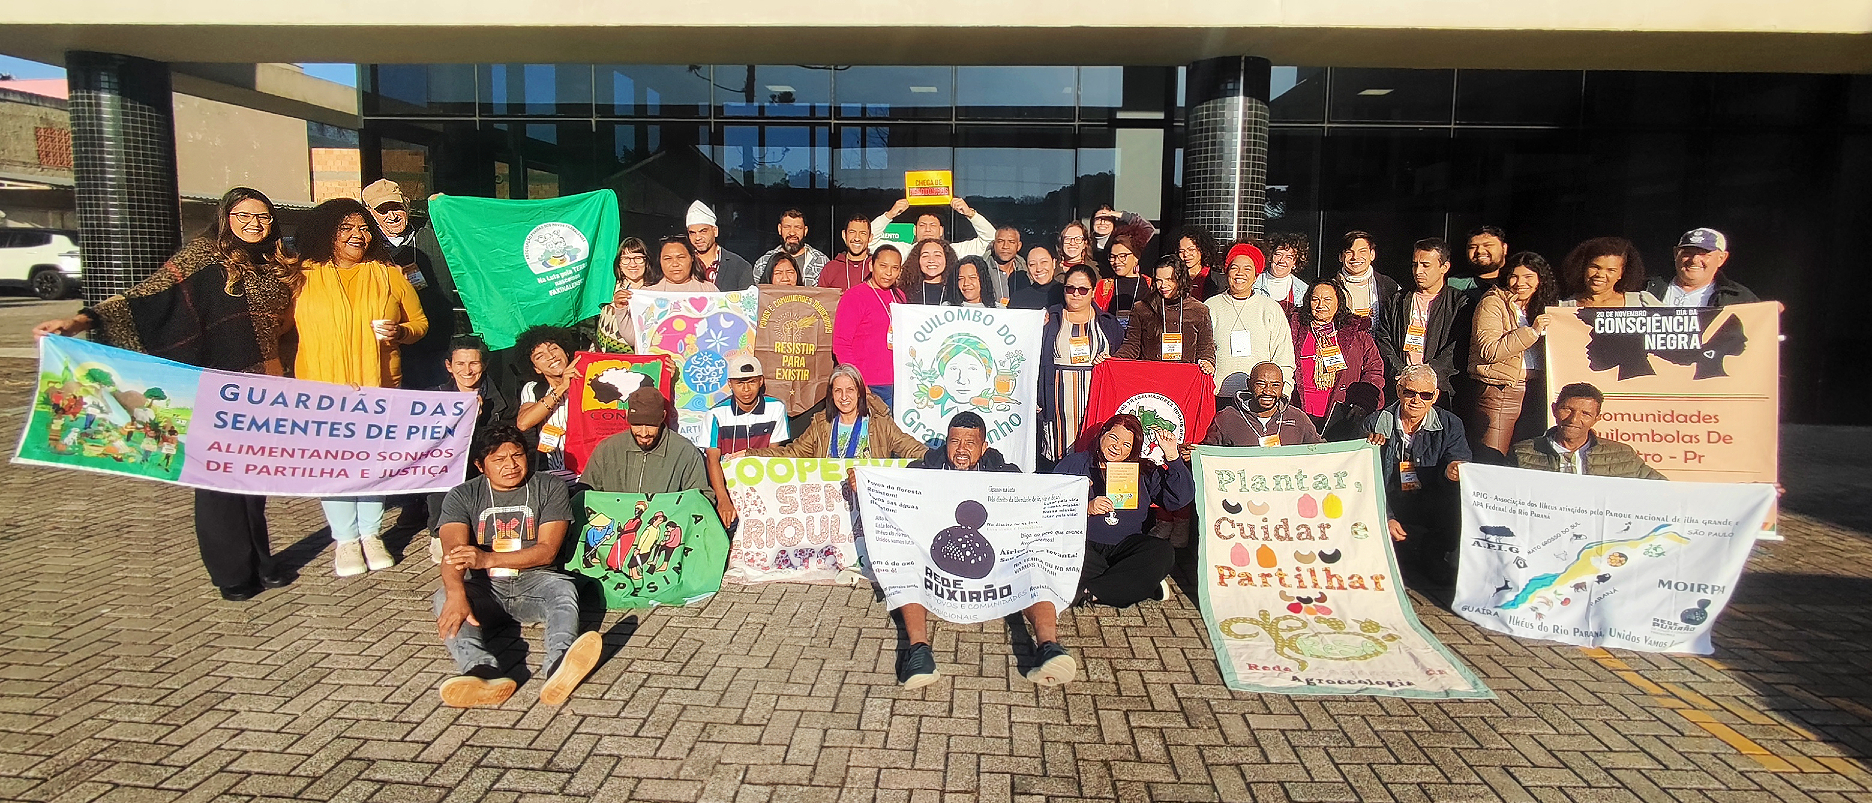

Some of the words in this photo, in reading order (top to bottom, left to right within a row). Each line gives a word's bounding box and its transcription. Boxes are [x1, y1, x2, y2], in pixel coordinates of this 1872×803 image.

[546, 273, 560, 281] Luta
[914, 308, 994, 343] QUILOMBO
[997, 324, 1017, 346] DO
[1595, 313, 1701, 333] CONSCIÊNCIA
[775, 342, 815, 355] RESISTIR
[1645, 334, 1701, 350] NEGRA
[782, 355, 805, 367] PARA
[776, 368, 809, 380] EXISTIR
[219, 383, 387, 415] GUARDIÃS
[410, 401, 465, 416] DAS
[591, 412, 626, 420] CON
[1599, 410, 1719, 424] omunidades
[213, 411, 361, 439] SEMENTES
[366, 423, 396, 440] DE
[406, 420, 456, 440] PIÉN
[1598, 428, 1700, 443] uilombolas
[1707, 431, 1733, 444] De
[207, 441, 371, 462] ALIMENTANDO
[376, 448, 454, 462] SONHOS
[1637, 451, 1662, 463] tro
[1684, 451, 1705, 464] Pr
[206, 461, 234, 473] DE
[245, 463, 349, 478] PARTILHA
[360, 467, 370, 478] E
[379, 465, 449, 480] JUSTIÇA
[1215, 468, 1363, 493] Plantar,
[897, 487, 922, 495] floresta
[1472, 491, 1487, 500] APIG
[1527, 500, 1537, 508] dos
[1590, 508, 1603, 516] pelo
[1485, 503, 1507, 512] Federal
[1213, 517, 1331, 542] Cuidar
[1350, 522, 1369, 540] e
[1527, 546, 1541, 555] MATO
[1542, 533, 1561, 547] GROSSO
[1014, 563, 1036, 574] VAMOS
[925, 566, 963, 589] REDE
[1215, 564, 1385, 592] Partilhar
[924, 577, 1012, 602] PUXIRÃO
[1590, 587, 1618, 606] PARANÁ
[968, 589, 1027, 609] COMUNIDADES
[1461, 605, 1499, 617] GUAÍRA
[1509, 615, 1534, 629] Ilhéus
[1538, 622, 1548, 632] do
[1553, 625, 1569, 635] Rio
[1609, 627, 1640, 643] Unidos
[1652, 622, 1696, 632] PUXIRÃO
[1653, 618, 1678, 626] REDE
[1247, 663, 1293, 672] Rede
[1291, 675, 1415, 687] Agroecologia
